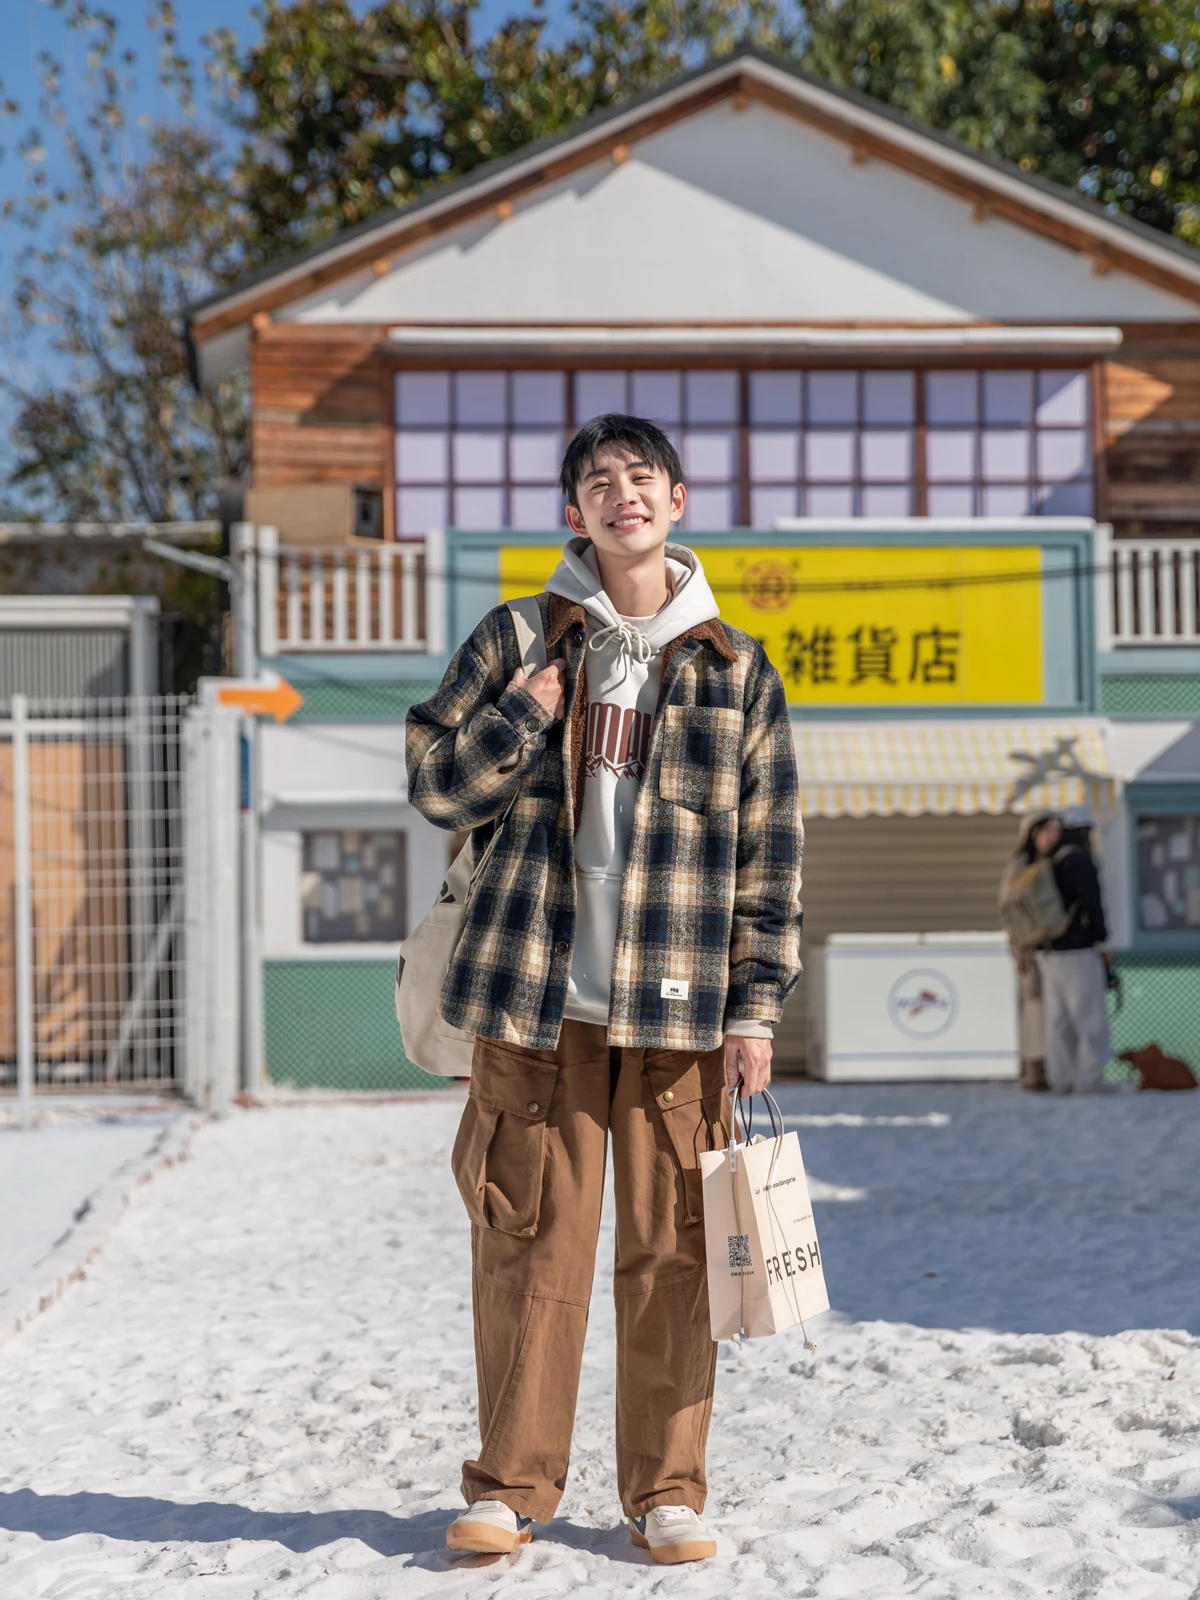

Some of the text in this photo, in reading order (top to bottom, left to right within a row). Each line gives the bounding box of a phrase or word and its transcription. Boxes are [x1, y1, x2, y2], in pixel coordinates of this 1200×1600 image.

[758, 623, 961, 686] 雑貨店
[772, 1176, 796, 1189] oulangerie
[766, 1241, 821, 1286] FRESH
